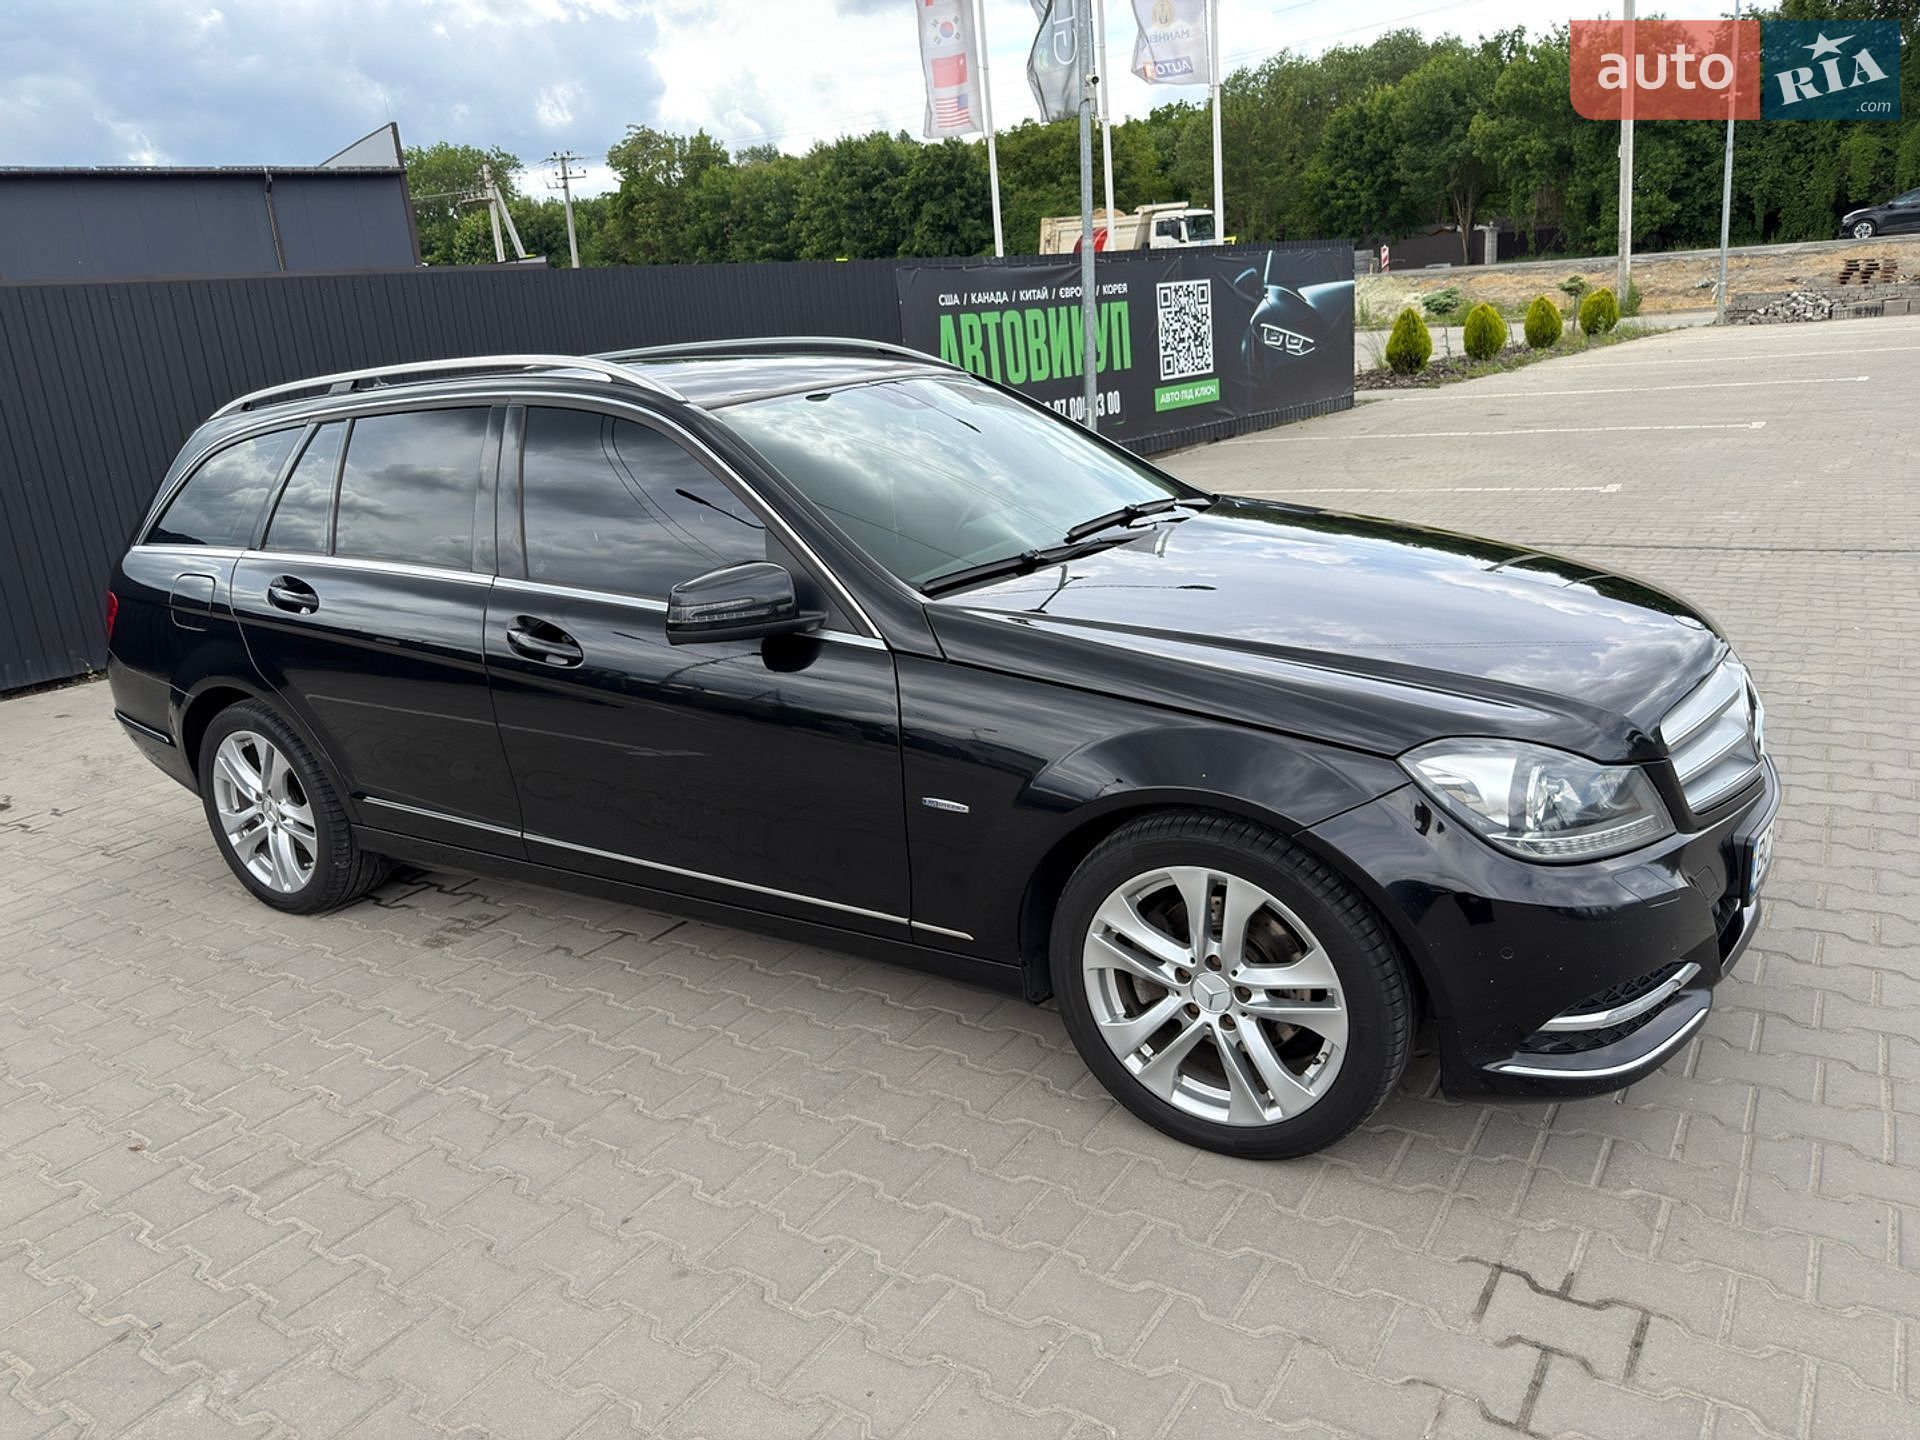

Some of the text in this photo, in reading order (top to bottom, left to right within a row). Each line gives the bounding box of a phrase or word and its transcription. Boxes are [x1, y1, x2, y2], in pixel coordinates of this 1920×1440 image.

[938, 293, 960, 306] США
[970, 291, 1009, 305] КАНАДА
[1020, 286, 1049, 301] КИТАЙ
[1059, 285, 1084, 298] ЄВРО
[1103, 283, 1128, 296] КОРЕЯ
[1107, 390, 1120, 415] 00
[1160, 391, 1180, 404] АВТО
[1194, 384, 1216, 398] КЛЮЧ
